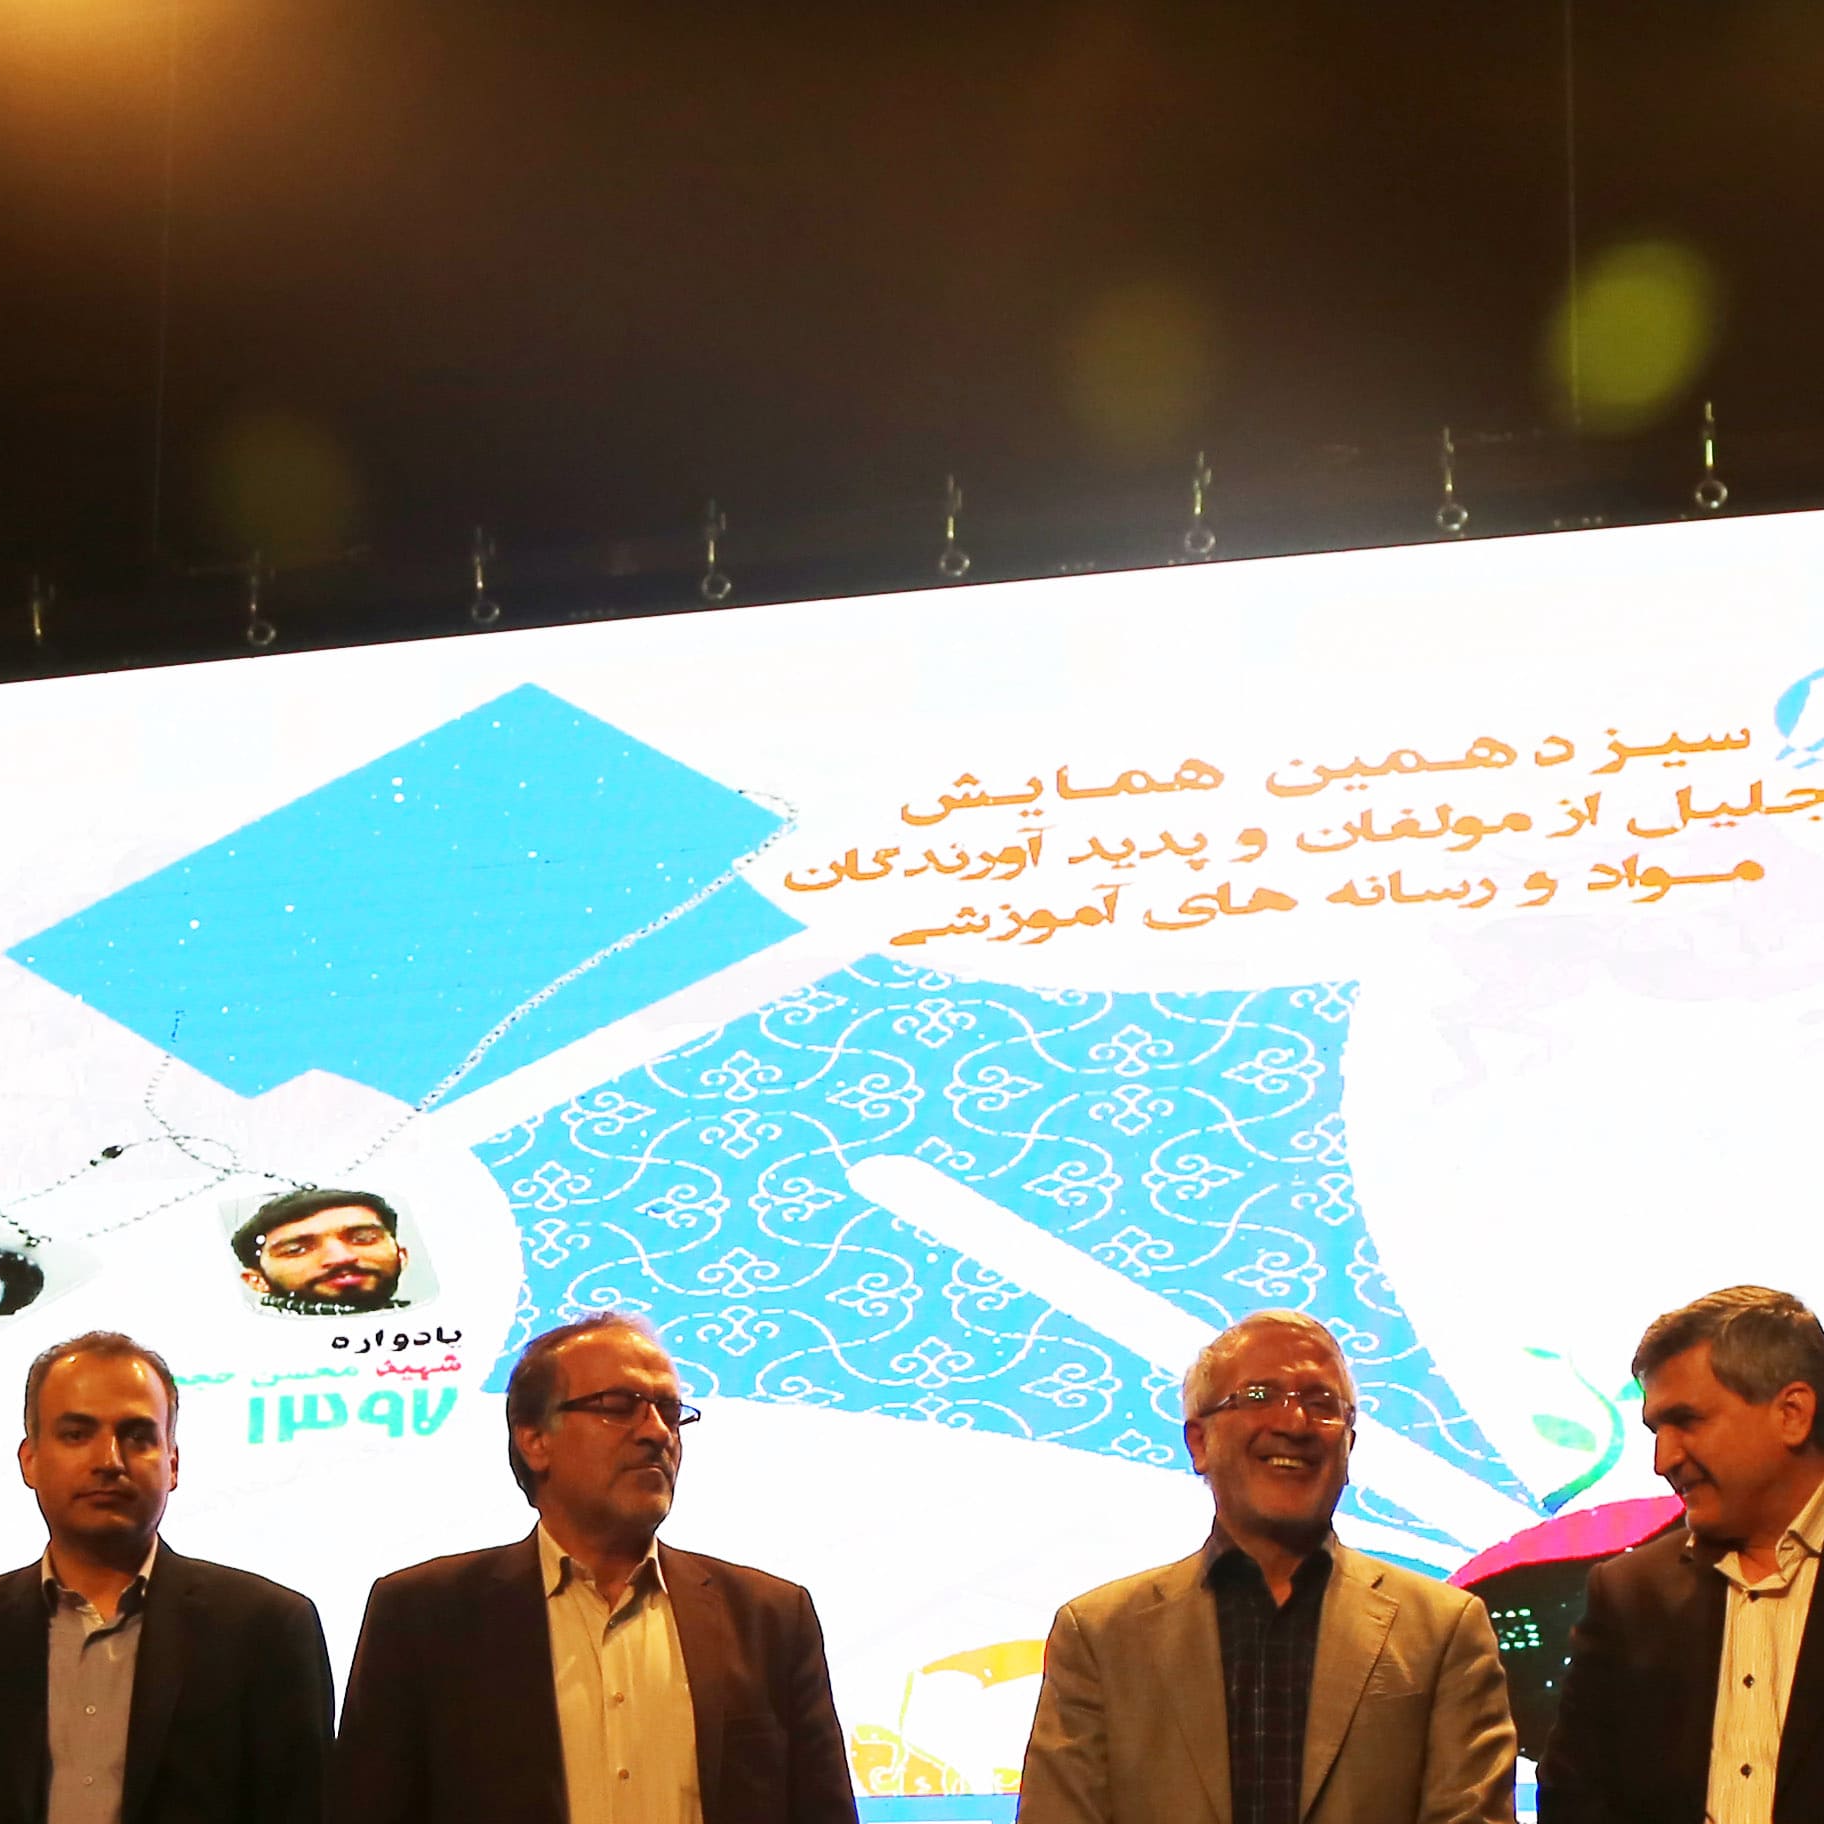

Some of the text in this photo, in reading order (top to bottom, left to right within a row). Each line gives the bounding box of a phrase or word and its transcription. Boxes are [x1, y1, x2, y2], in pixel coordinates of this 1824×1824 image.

[900, 758, 1225, 828] همایش
[1547, 792, 1602, 840] از
[1067, 830, 1209, 873] پدید
[1231, 827, 1268, 864] و
[1295, 803, 1534, 854] مولفان
[888, 853, 1766, 947] مواد و رسانه های آموزشی
[331, 1326, 463, 1354] یادواره
[173, 1354, 463, 1392] شهید محسن حجج
[247, 1386, 459, 1446] ۱۳۹۷
